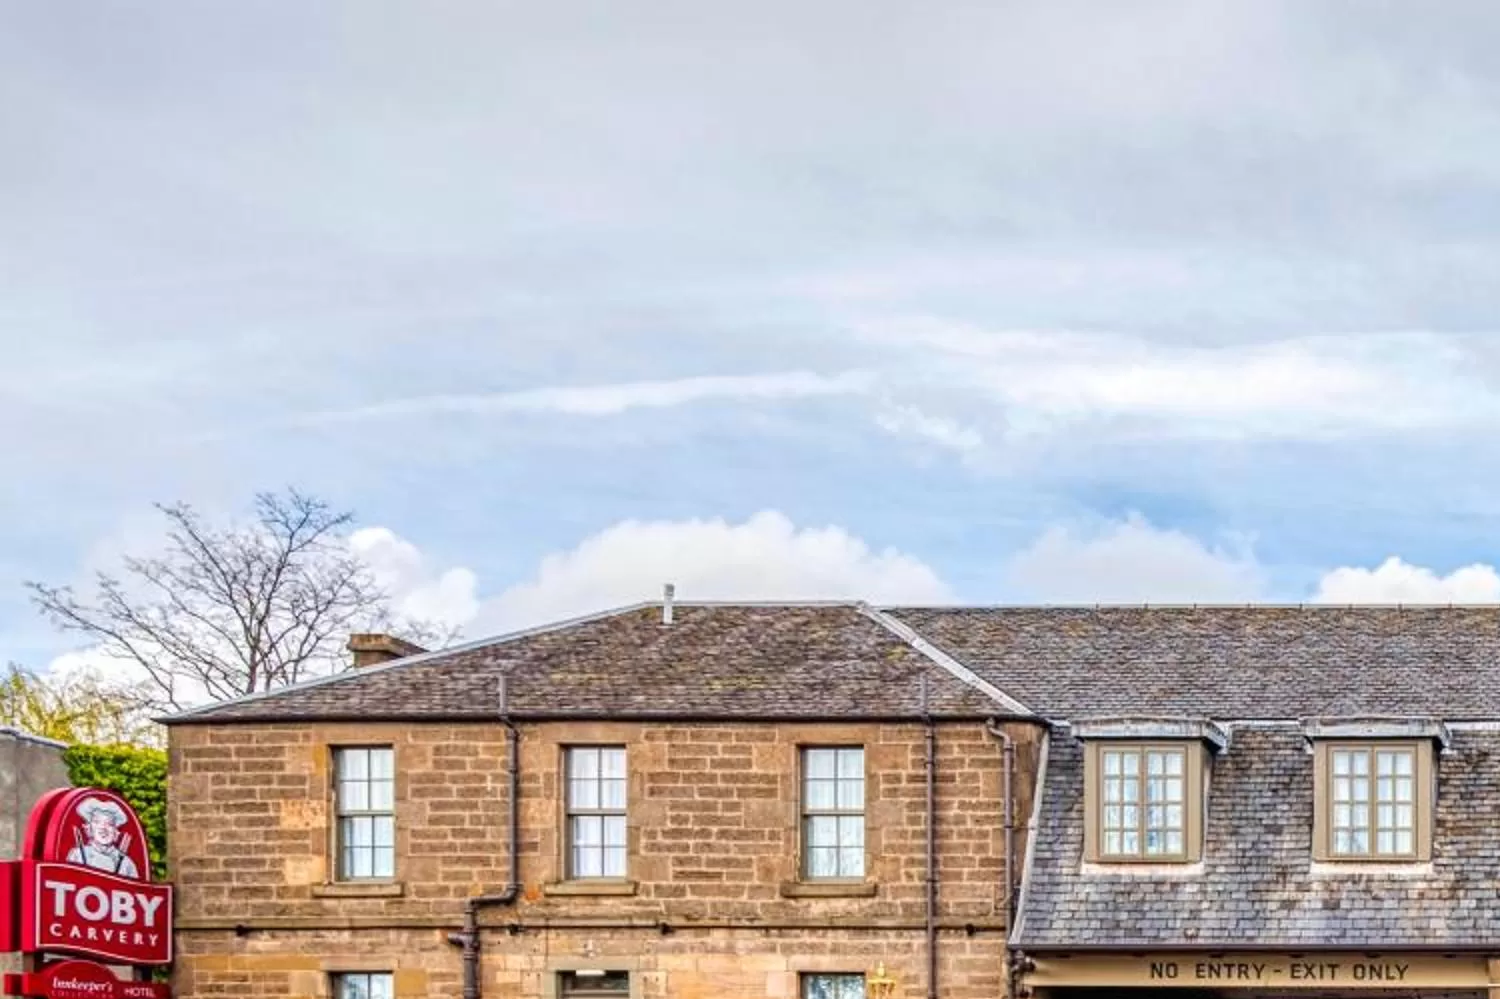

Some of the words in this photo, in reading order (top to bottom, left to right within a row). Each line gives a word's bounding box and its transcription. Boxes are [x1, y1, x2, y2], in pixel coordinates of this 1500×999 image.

[45, 880, 163, 927] TOBY
[49, 923, 159, 946] CARVERY
[1150, 963, 1179, 979] NO
[1195, 963, 1267, 979] ENTRY
[1290, 963, 1340, 980] EXIT
[1353, 963, 1409, 980] ONLY
[52, 976, 113, 992] Innkeeper's
[124, 987, 156, 998] HOTEL
